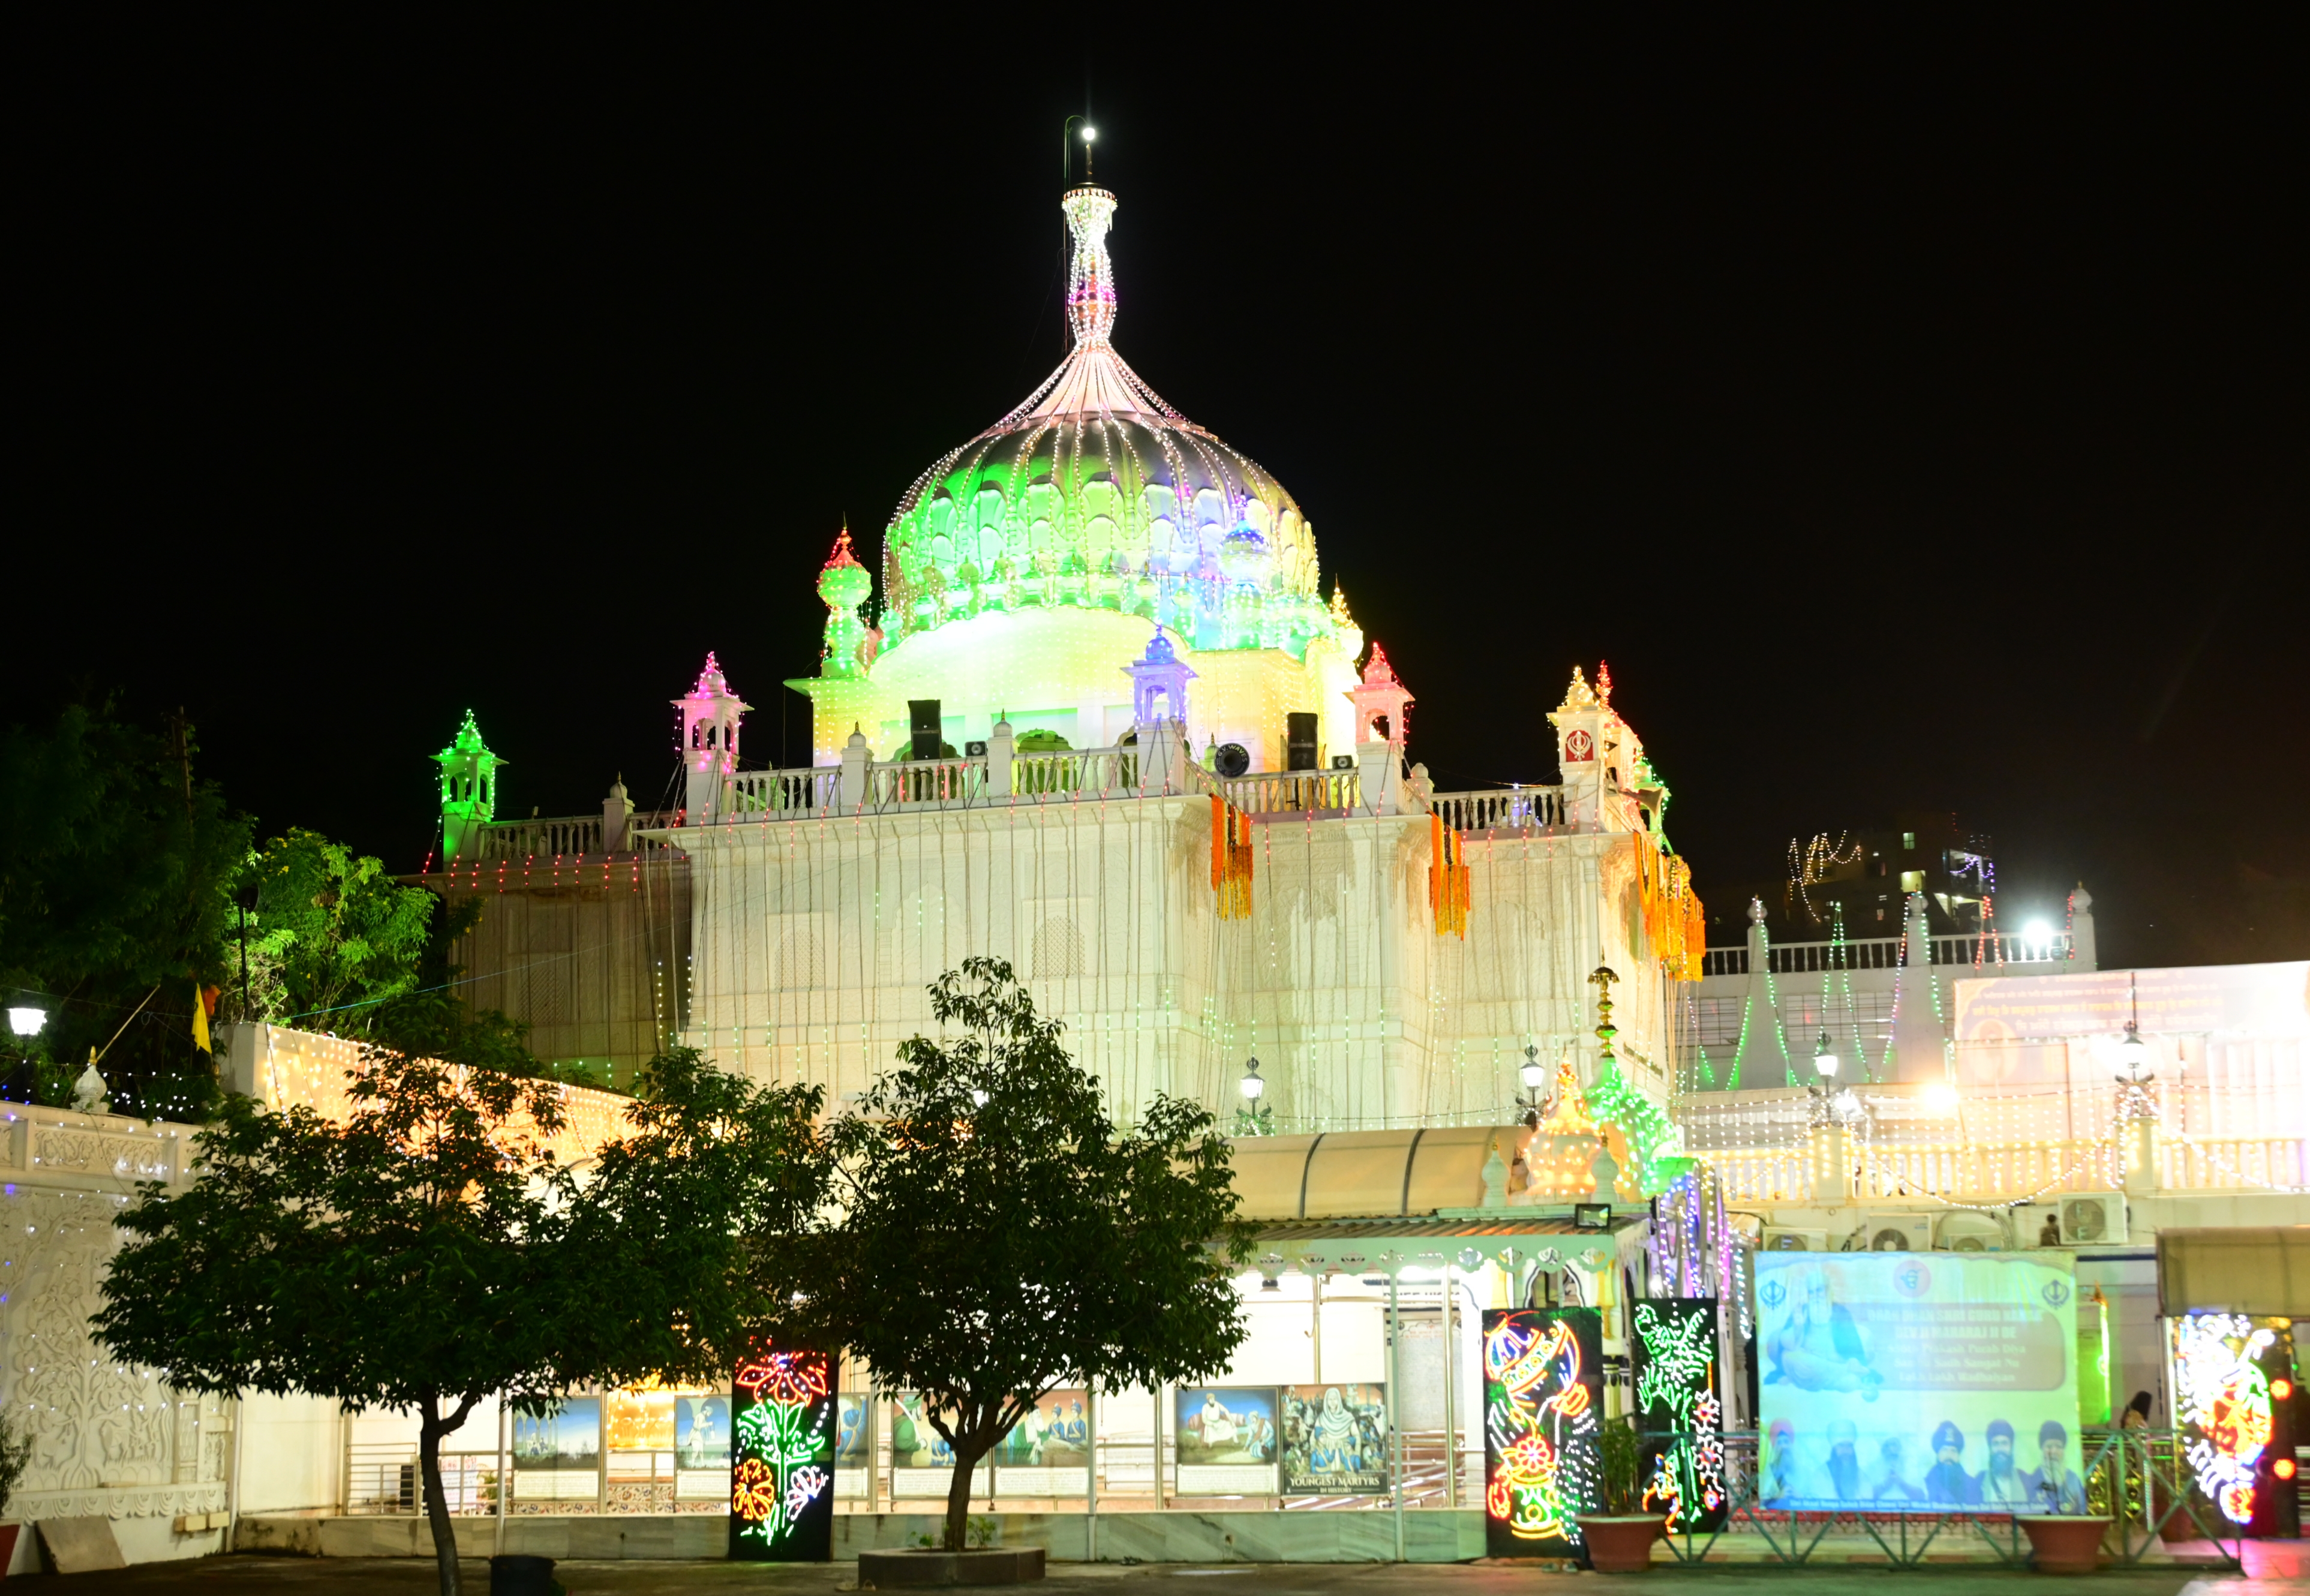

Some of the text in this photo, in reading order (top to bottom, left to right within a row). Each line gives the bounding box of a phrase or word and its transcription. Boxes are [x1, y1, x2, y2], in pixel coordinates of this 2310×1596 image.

[1967, 1309, 2000, 1322] GURU
[1290, 1477, 1380, 1487] YOUNGEST MARTYRS
